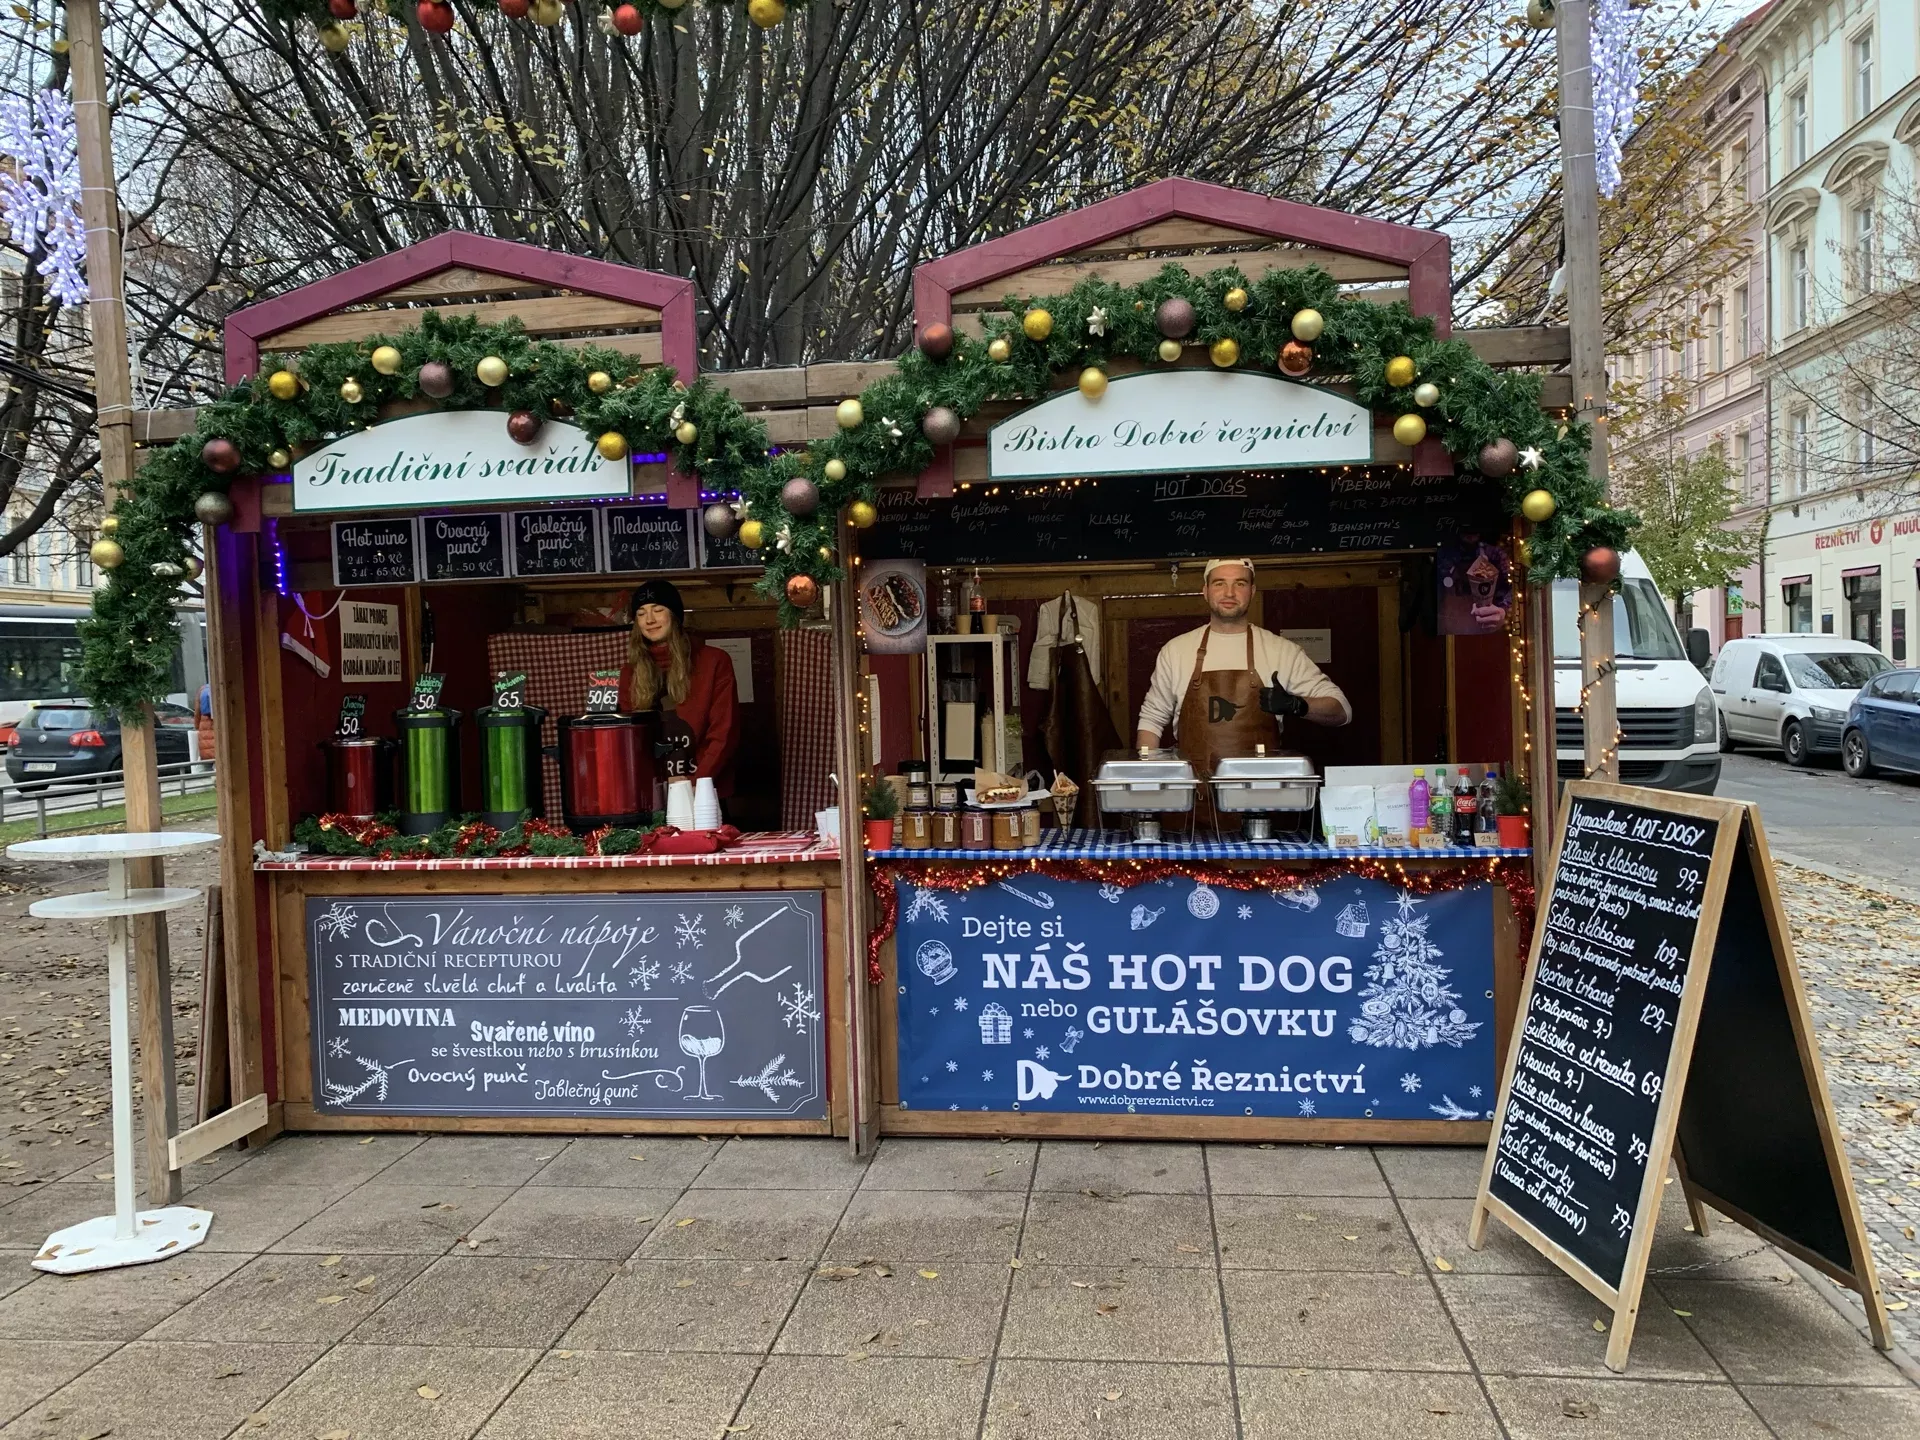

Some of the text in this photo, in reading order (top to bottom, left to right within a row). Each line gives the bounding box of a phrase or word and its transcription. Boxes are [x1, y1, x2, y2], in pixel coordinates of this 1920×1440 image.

[1003, 412, 1360, 454] Bistro Dobré řeznictví
[309, 441, 609, 488] Tradiční svařák
[1154, 477, 1247, 497] HOT DOGS
[1424, 493, 1459, 504] BREW
[951, 502, 1011, 522] GULÁŠOVKA
[1028, 514, 1065, 523] HOUSCE
[1088, 513, 1133, 526] KLASIK
[1168, 510, 1206, 521] SALSA
[436, 520, 490, 546] Ovocný
[521, 516, 587, 543] Jablečný
[613, 516, 682, 535] Medovina
[968, 520, 998, 534] 69,-
[1113, 528, 1139, 543] 99,-
[1176, 524, 1206, 539] 109,-
[1281, 520, 1310, 529] SALSA
[1328, 519, 1400, 533] BEANSMITH'S
[342, 528, 407, 547] Hot wine
[537, 535, 573, 559] punč
[648, 542, 661, 551] 65
[1036, 532, 1068, 550] 79,-
[1270, 534, 1303, 548] 129,-
[1340, 535, 1395, 548] ETIOPIE
[373, 554, 385, 564] 50
[447, 537, 481, 563] punč
[745, 550, 758, 559] 65
[376, 567, 388, 577] 65
[463, 563, 475, 571] 50
[553, 558, 567, 567] 50
[1570, 803, 1705, 846] Vymazlené HOT-DOGY
[1562, 840, 1703, 894] Klasik s klobásou 99,-
[1556, 866, 1577, 885] (Naše
[1618, 885, 1647, 910] okurka,
[1552, 886, 1630, 919] petrželové pesto)
[962, 915, 1065, 944] Dejte si
[1548, 904, 1685, 970] Salsa s klobásou 109,-
[425, 907, 660, 978] Vánoční nápoje
[335, 950, 562, 968] S TRADIČNÍ RECEPTUROU
[982, 942, 1354, 993] NÁŠ HOT DOG
[1559, 939, 1583, 962] salsa,
[1583, 945, 1622, 976] koriandr,
[1650, 974, 1686, 998] pesto)
[342, 973, 618, 995] zaručeně skvělá chuť a kvalita
[1536, 959, 1673, 1034] Vepřové trhané 129,-
[338, 1007, 456, 1028] MEDOVINA
[1021, 998, 1337, 1037] nebo GULÁŠOVKU
[470, 1020, 595, 1042] Svařené víno
[431, 1046, 448, 1058] se
[452, 1040, 523, 1058] švestkou
[528, 1039, 563, 1058] nebo
[567, 1047, 575, 1058] s
[1524, 1016, 1662, 1103] Gulášovka od řezníka 69,-
[408, 1063, 529, 1091] Ovocný punč
[1078, 1059, 1366, 1094] Dobré Řeznictví
[534, 1079, 638, 1105] Jablečný punč
[1077, 1094, 1215, 1108] www.dobrereznictvi.cz
[1511, 1071, 1537, 1100] Naše
[1536, 1089, 1576, 1121] sekaná
[1580, 1104, 1615, 1146] housce
[1628, 1133, 1649, 1165] 79,-
[1524, 1111, 1553, 1142] okurka,
[1553, 1130, 1576, 1153] naše
[1500, 1123, 1575, 1198] Teplé škvarky
[1541, 1191, 1587, 1236] MALDON)
[1610, 1203, 1633, 1239] 79,-
